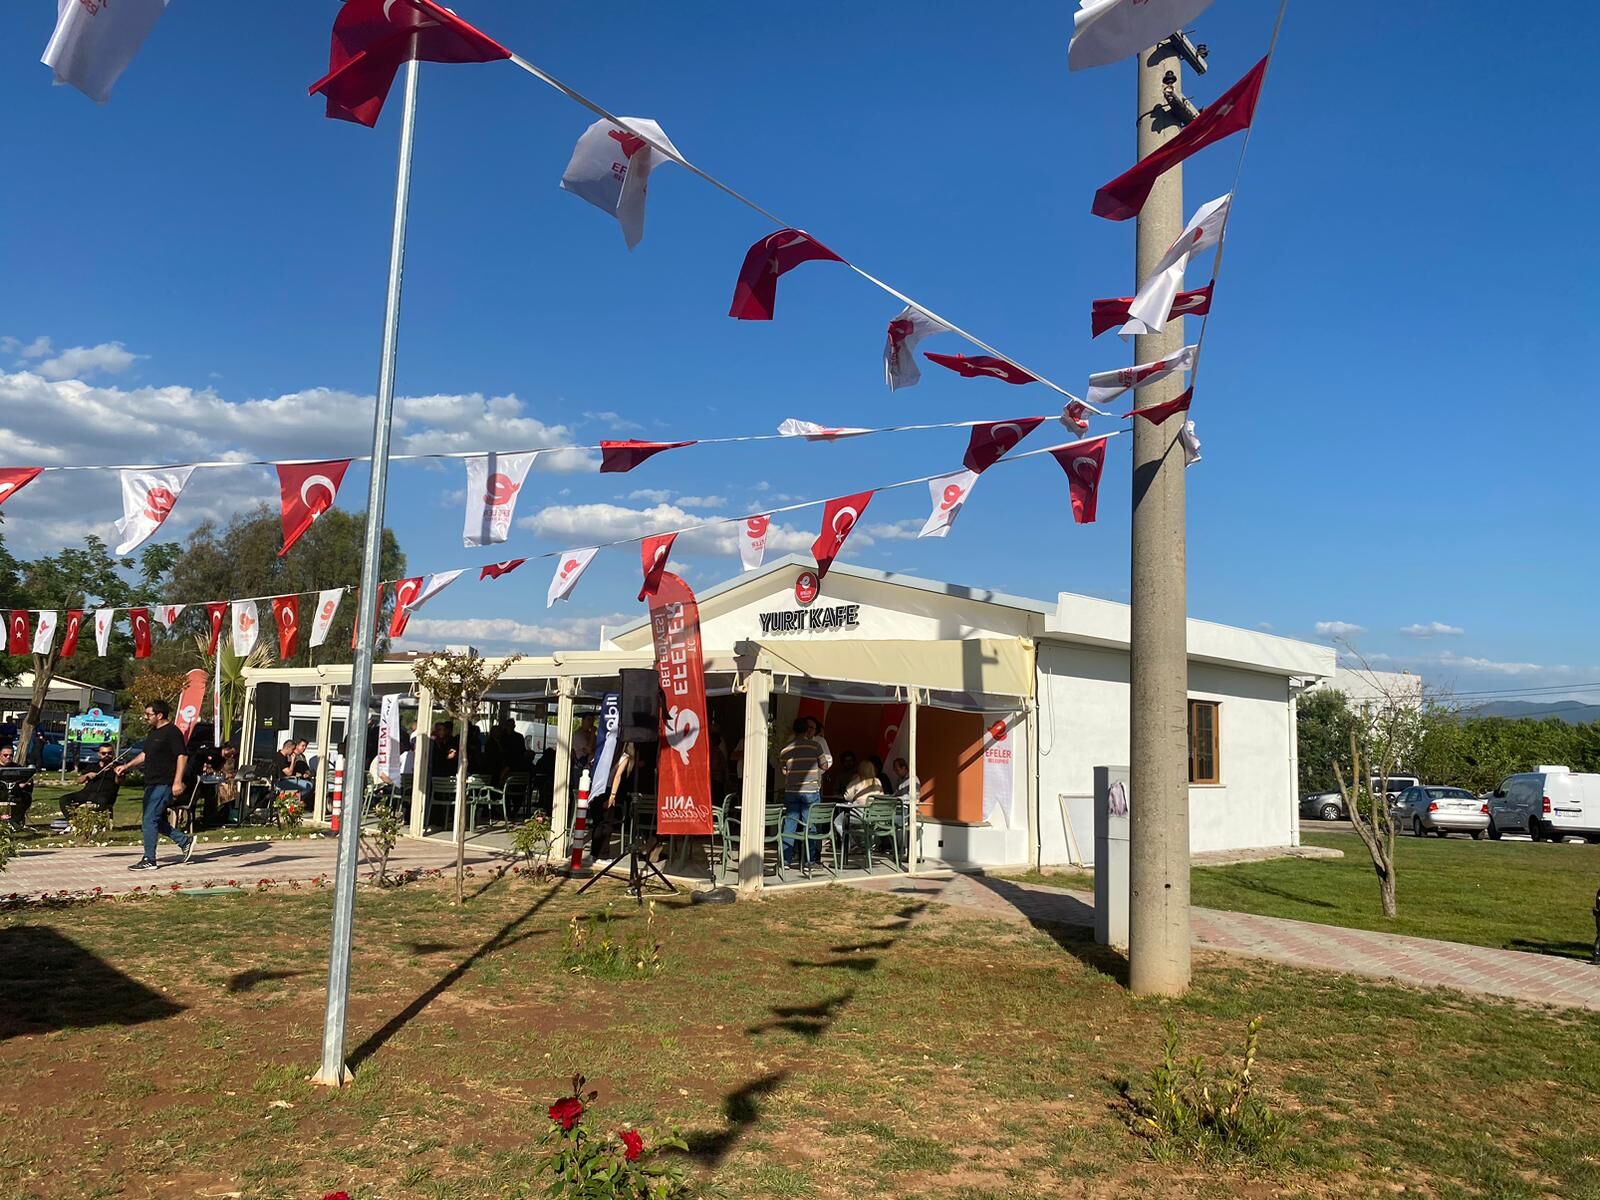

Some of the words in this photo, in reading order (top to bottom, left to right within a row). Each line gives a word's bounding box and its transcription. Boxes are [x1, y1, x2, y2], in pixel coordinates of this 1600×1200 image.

[760, 609, 808, 632] YURT
[809, 605, 860, 628] KAFE
[985, 749, 1011, 758] EFELER
